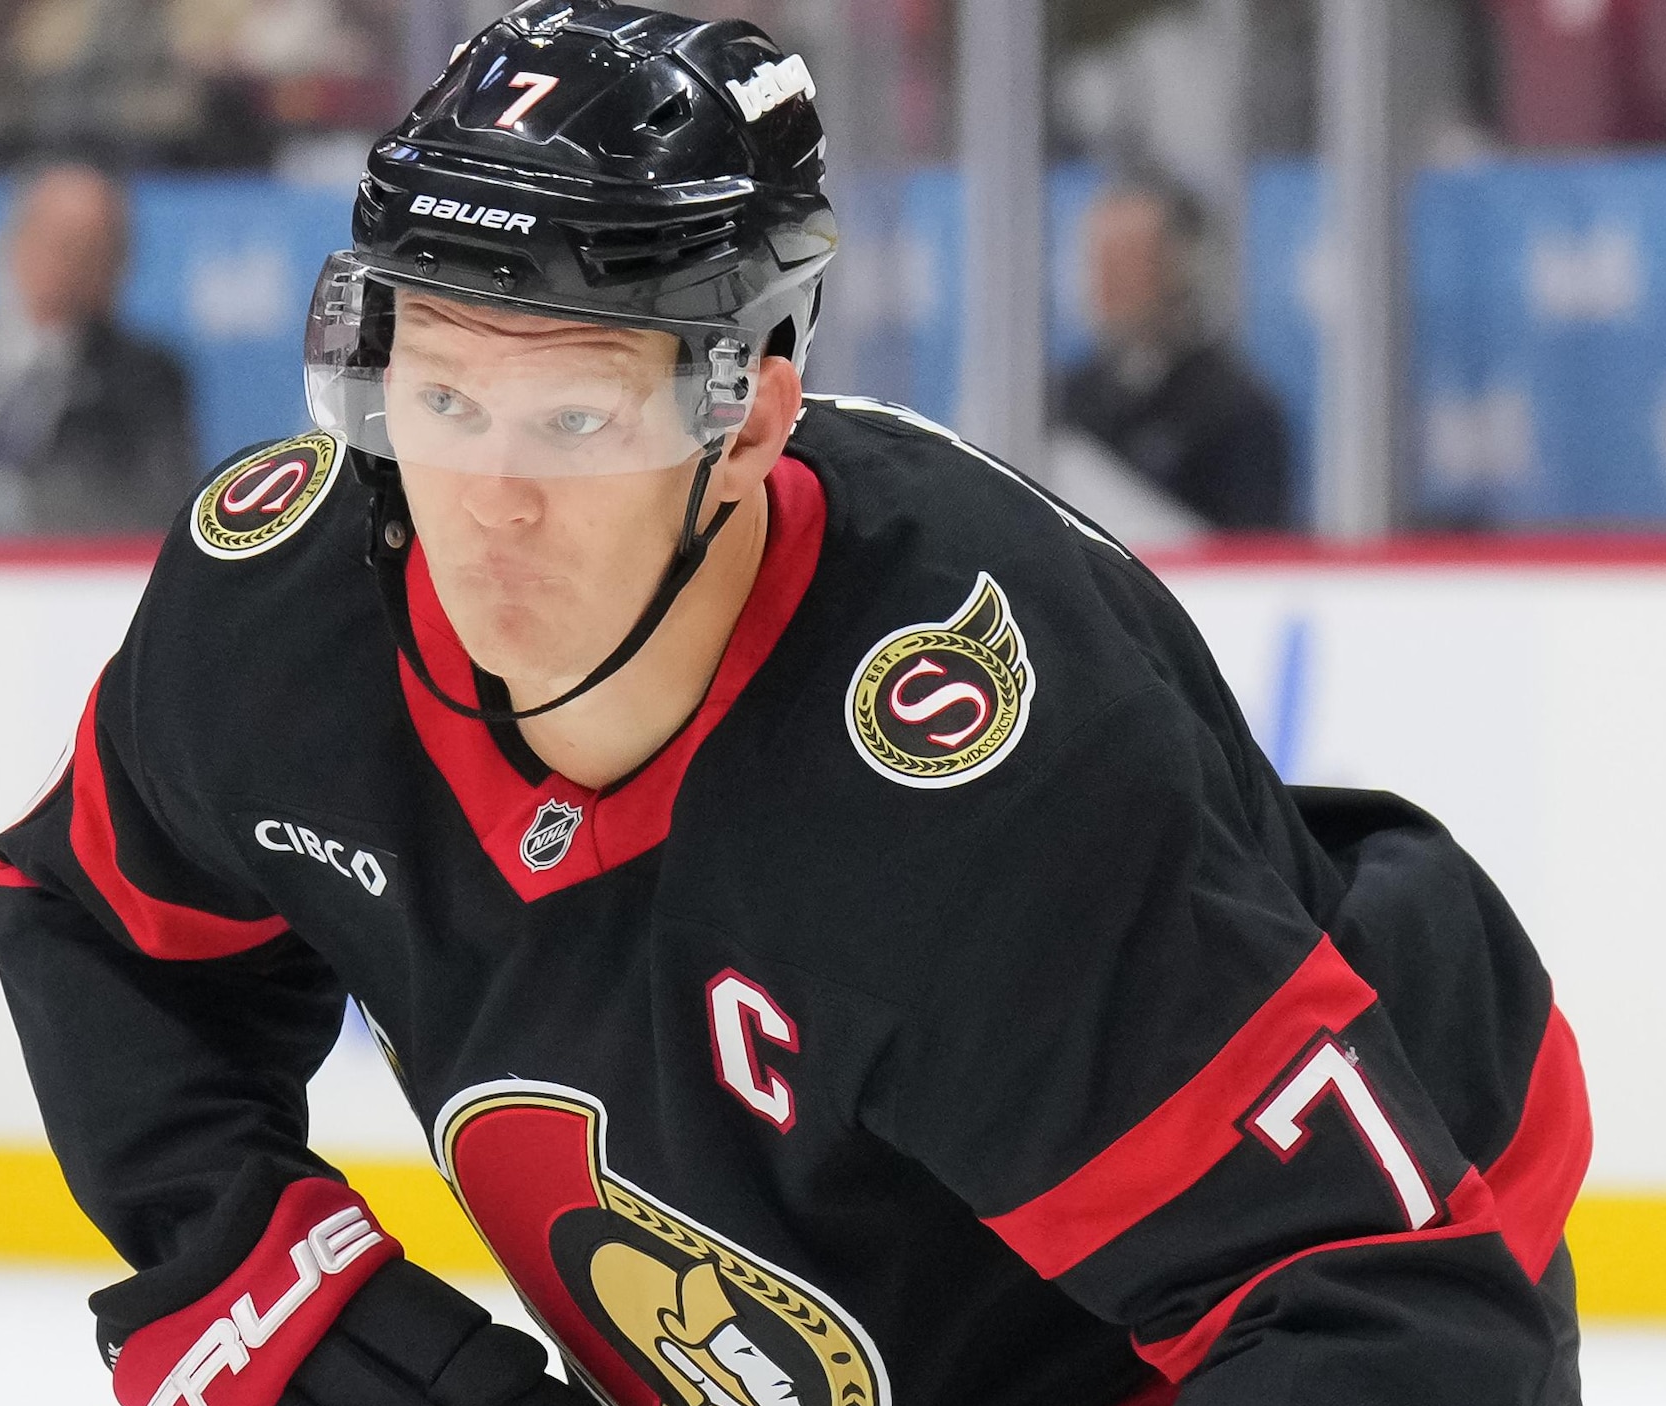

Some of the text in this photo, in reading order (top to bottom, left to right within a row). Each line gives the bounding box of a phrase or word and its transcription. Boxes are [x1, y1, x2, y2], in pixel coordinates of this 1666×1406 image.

[494, 70, 560, 131] 7
[408, 194, 537, 236] BAUER
[221, 458, 309, 518] S
[865, 652, 902, 684] EST.
[887, 655, 991, 749] S
[253, 818, 354, 879] CIBC
[529, 819, 571, 854] NHL
[705, 966, 801, 1136] C
[1243, 1032, 1441, 1232] 7
